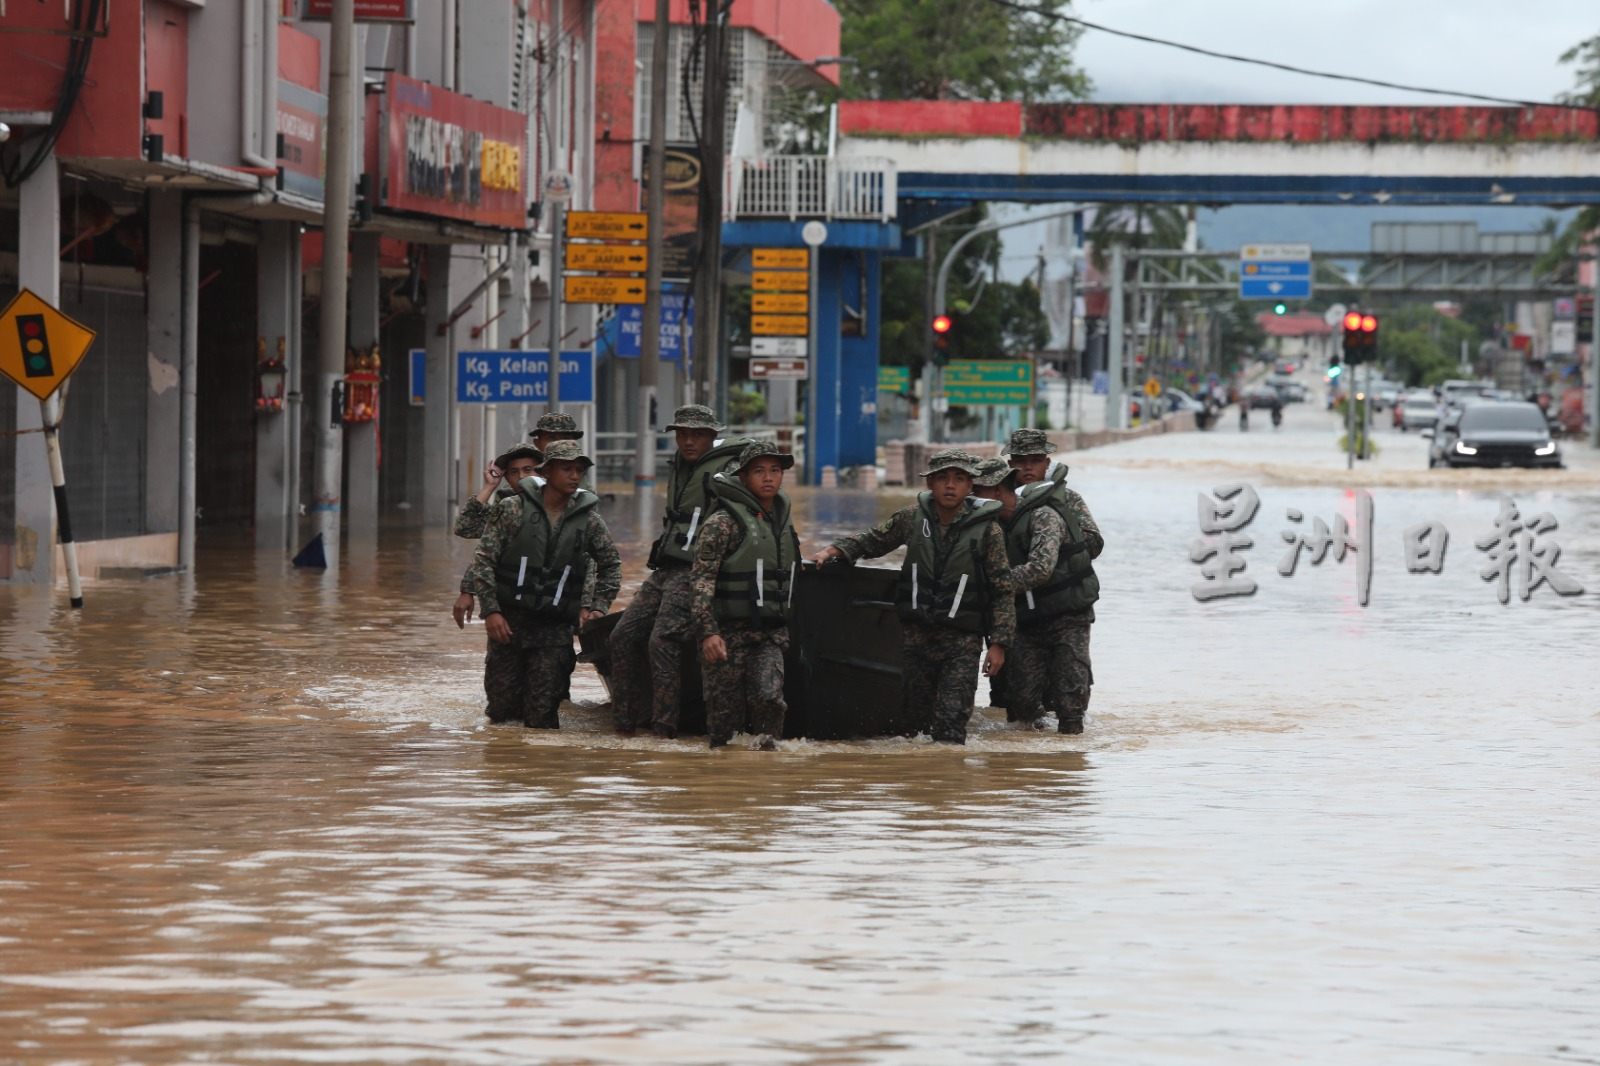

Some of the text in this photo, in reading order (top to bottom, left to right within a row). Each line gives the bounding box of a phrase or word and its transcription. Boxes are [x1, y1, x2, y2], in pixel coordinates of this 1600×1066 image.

[465, 357, 580, 378] Kg. Kelanan
[465, 381, 549, 401] Kg. Panti
